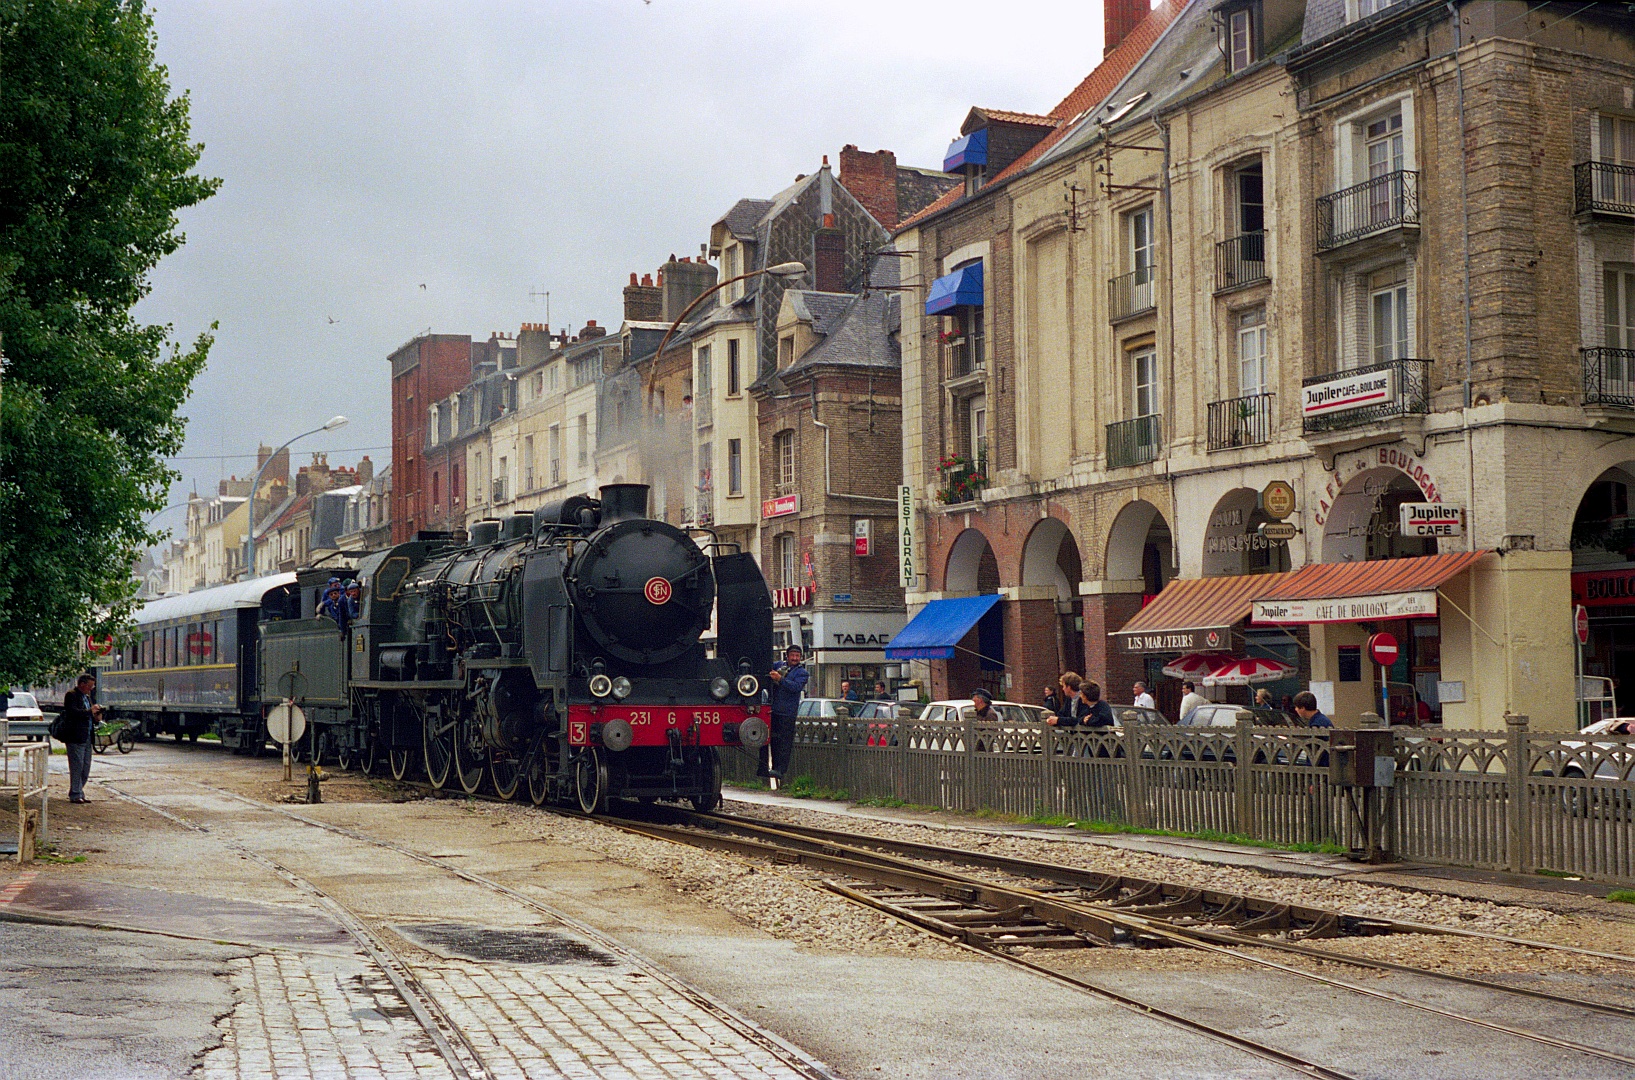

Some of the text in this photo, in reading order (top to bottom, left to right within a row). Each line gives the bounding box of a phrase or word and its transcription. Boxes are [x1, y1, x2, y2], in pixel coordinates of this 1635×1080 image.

[1307, 387, 1341, 404] Jupiler
[1360, 378, 1387, 394] BOULOGNE
[1409, 506, 1458, 521] Jupiler
[902, 486, 912, 586] RESTAURANT
[1417, 525, 1452, 535] CAFÉ
[772, 586, 807, 608] BALTO
[1261, 605, 1288, 619] Jupiler
[1337, 605, 1346, 618] DE
[833, 634, 889, 645] TABAC
[630, 711, 721, 725] 231 G 558
[572, 724, 584, 742] 3
